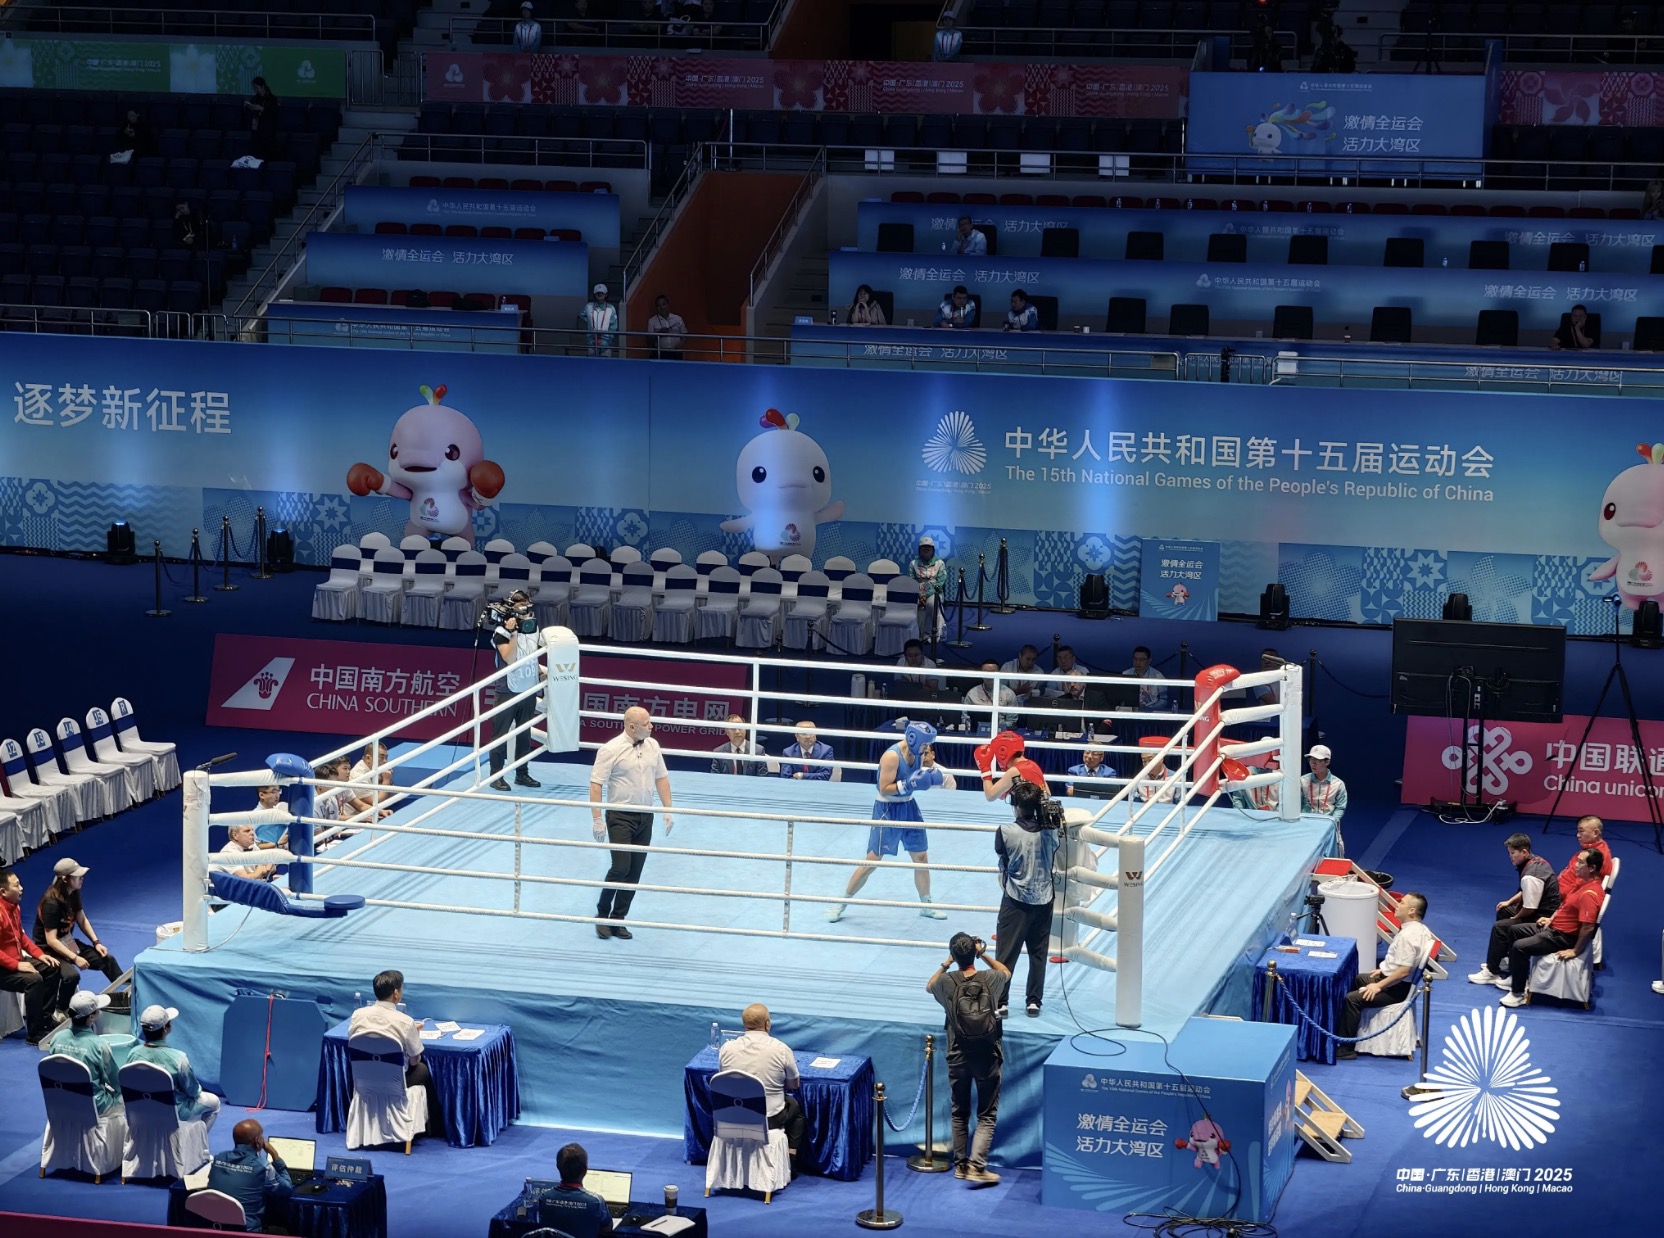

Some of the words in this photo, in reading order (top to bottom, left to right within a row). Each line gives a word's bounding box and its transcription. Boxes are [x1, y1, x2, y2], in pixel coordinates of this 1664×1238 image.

[746, 76, 765, 84] 2025
[946, 80, 964, 88] 2025
[1343, 115, 1424, 131] 激情全运会
[1342, 137, 1421, 152] 活力大湾区
[1505, 232, 1576, 244] 激情全运会
[1585, 234, 1656, 246] 活力大湾区
[382, 248, 444, 263] 激情全运会
[453, 251, 514, 265] 活力大湾区
[899, 268, 966, 282] 激情全运会
[974, 270, 1040, 284] 活力大湾区
[1484, 284, 1558, 300] 激情全运会
[1566, 287, 1638, 302] 活力大湾区
[14, 382, 232, 434] 逐梦新征程
[1004, 427, 1494, 478] 中华人民共和国第十五届运动会
[1005, 466, 1035, 480] The
[1042, 468, 1076, 483] 15th
[1082, 470, 1149, 486] National
[1155, 472, 1211, 489] Games
[1216, 475, 1232, 490] of
[1238, 476, 1264, 491] the
[1270, 478, 1338, 497] People's
[1344, 481, 1418, 500] Republic
[1422, 484, 1440, 500] of
[1445, 485, 1494, 502] China
[1160, 570, 1202, 580] 活力大湾区
[310, 664, 460, 696] 中国南方航空
[306, 692, 358, 712] CHINA
[654, 724, 696, 734] POWER
[699, 727, 728, 736] GRID
[1544, 774, 1600, 794] China
[1100, 1078, 1210, 1094] 中华人民共和国第十五届运动会
[1076, 1113, 1168, 1136] 激情全运会
[1076, 1136, 1165, 1158] 活力大湾区
